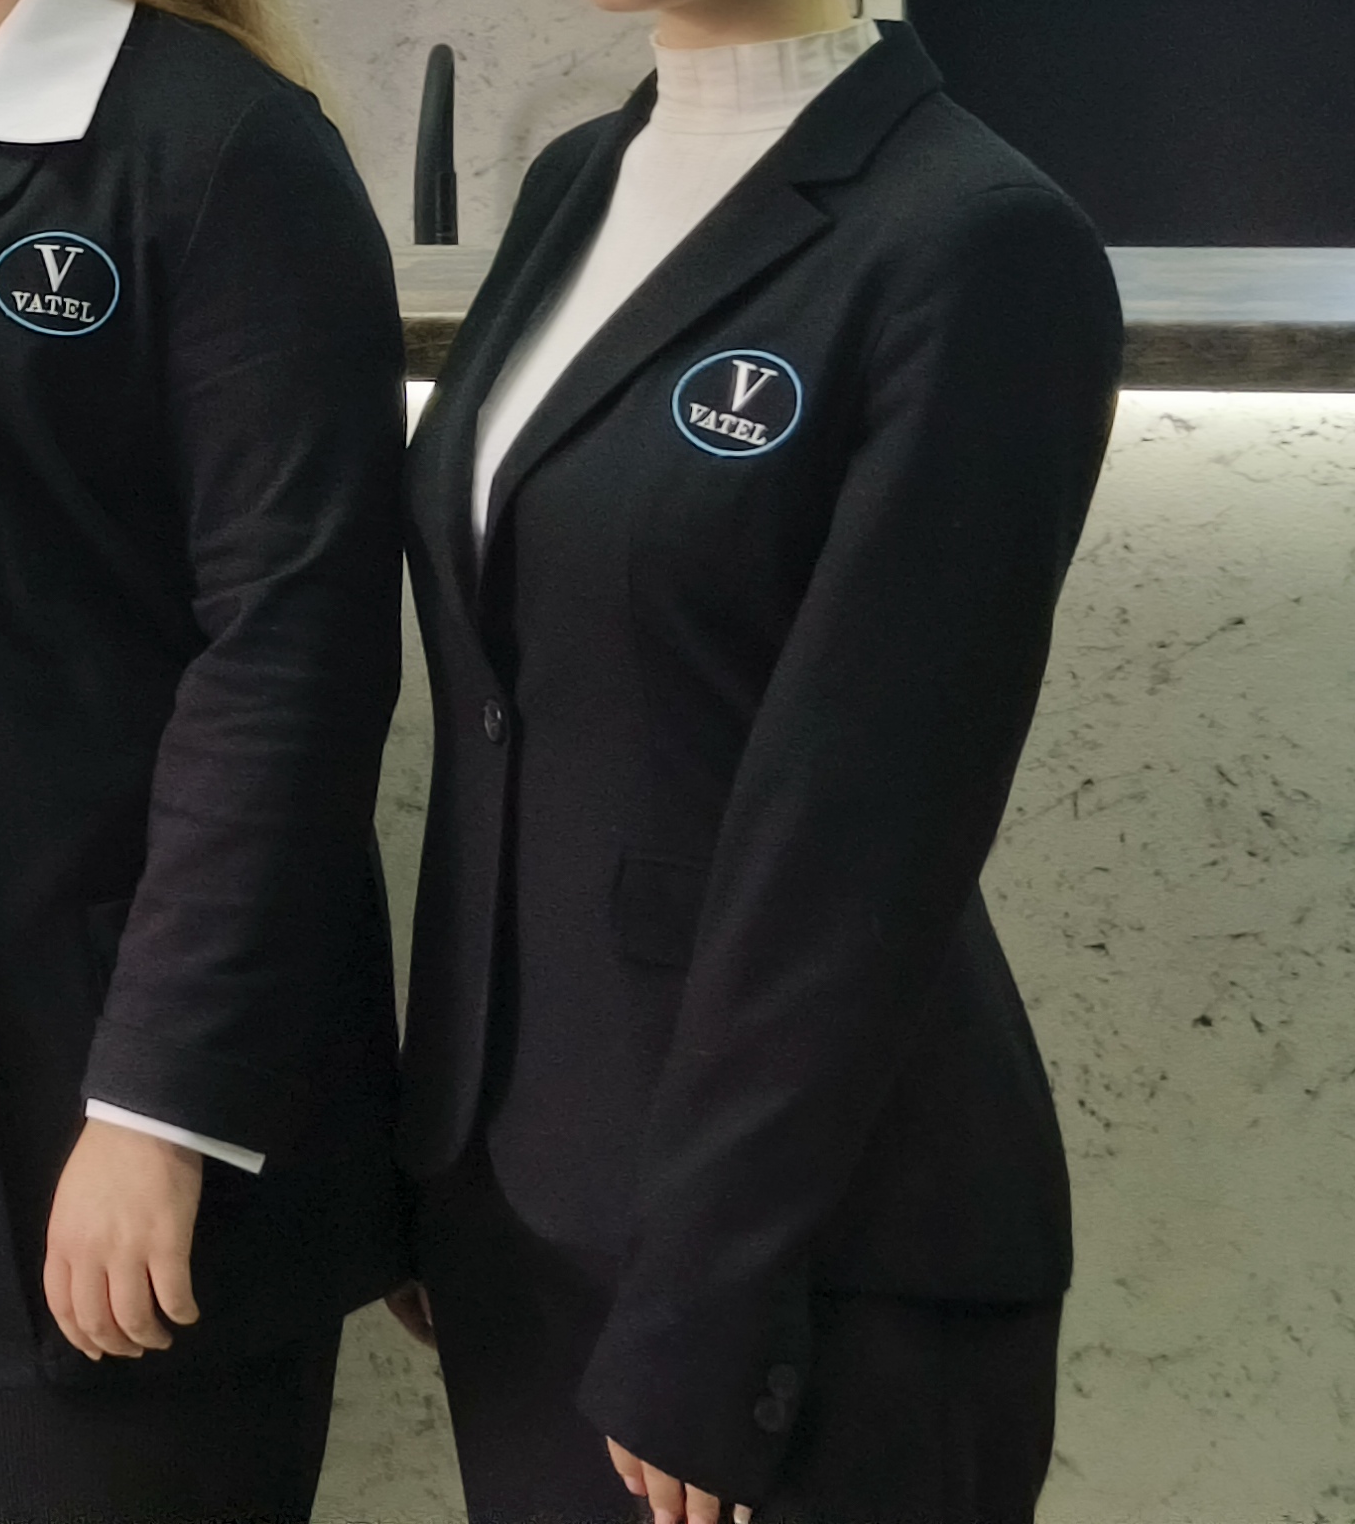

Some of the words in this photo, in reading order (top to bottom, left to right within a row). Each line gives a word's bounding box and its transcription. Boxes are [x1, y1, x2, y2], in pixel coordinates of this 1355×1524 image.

[33, 243, 85, 293] V
[11, 290, 95, 323] VATEL
[731, 359, 780, 412] V
[689, 402, 769, 446] VATEL
